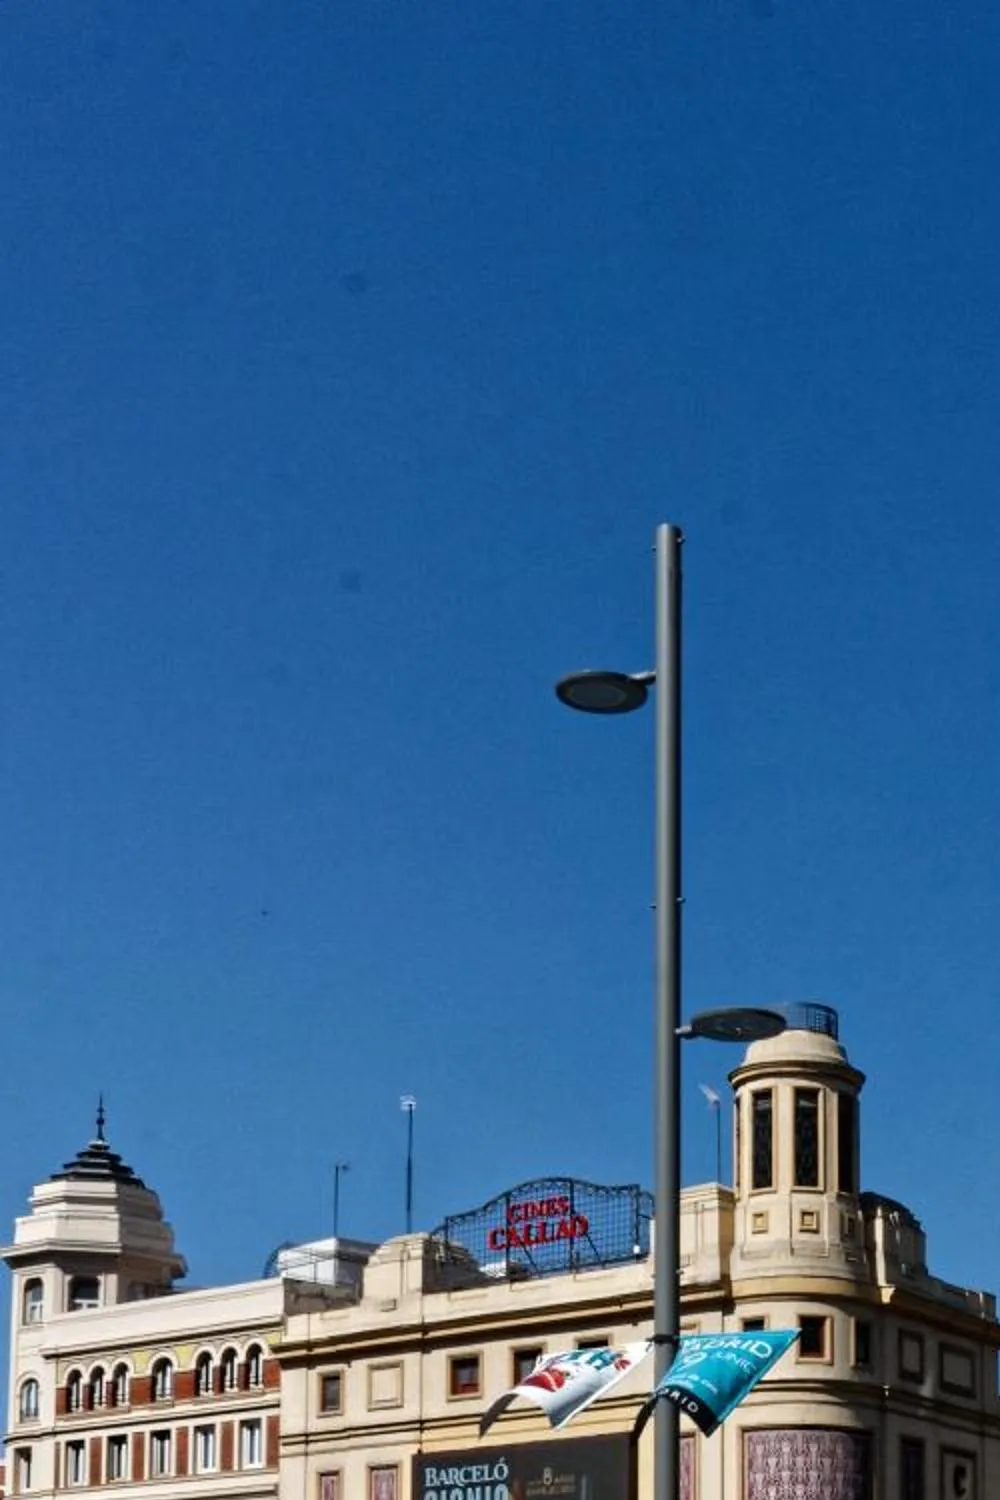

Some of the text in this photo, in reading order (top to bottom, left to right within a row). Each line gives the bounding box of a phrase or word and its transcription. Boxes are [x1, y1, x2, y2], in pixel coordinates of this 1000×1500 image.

[507, 1195, 569, 1223] CINES
[487, 1215, 589, 1251] CALLAO
[424, 1456, 509, 1487] BARCELÓ
